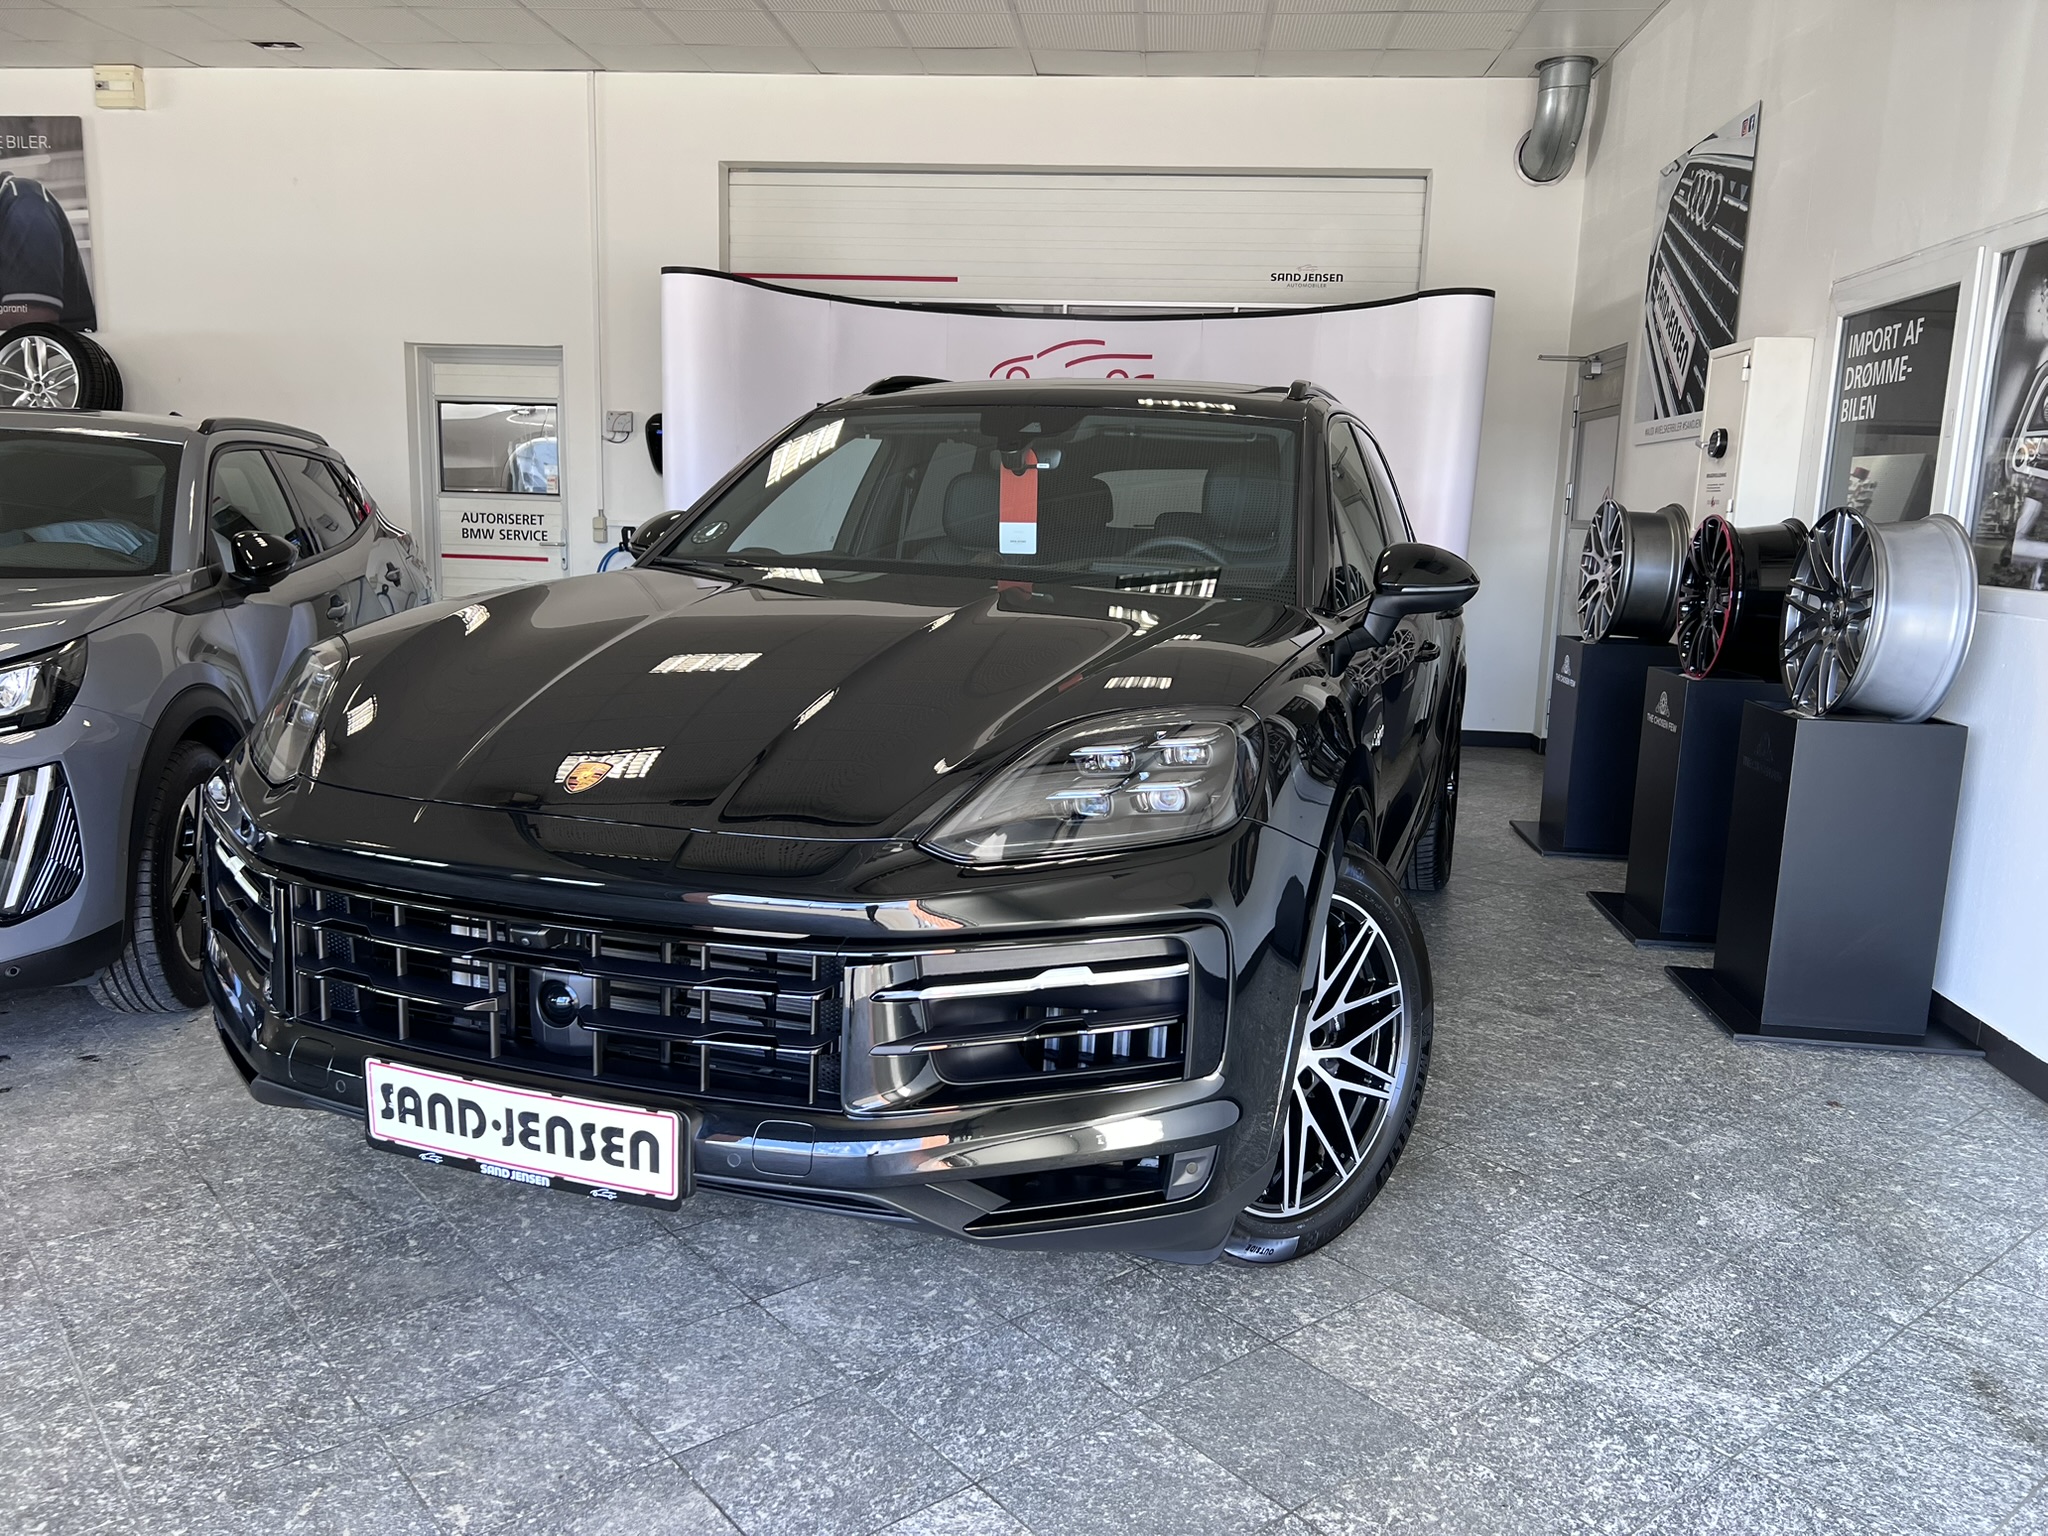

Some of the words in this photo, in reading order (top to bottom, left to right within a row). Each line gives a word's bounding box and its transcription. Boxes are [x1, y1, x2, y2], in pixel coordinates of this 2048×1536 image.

[6, 135, 51, 149] BILER.
[1270, 273, 1301, 282] SAND
[1303, 273, 1344, 282] JENSEN
[1848, 323, 1902, 358] IMPORT
[1903, 317, 1925, 347] AF
[1844, 355, 1913, 391] DRØMME-
[1840, 394, 1877, 422] BILEN
[461, 512, 544, 525] AUTORISERET
[462, 528, 494, 539] BMW
[499, 529, 548, 541] SERVICE
[480, 1164, 510, 1179] SAND
[510, 1170, 550, 1187] JENSEN
